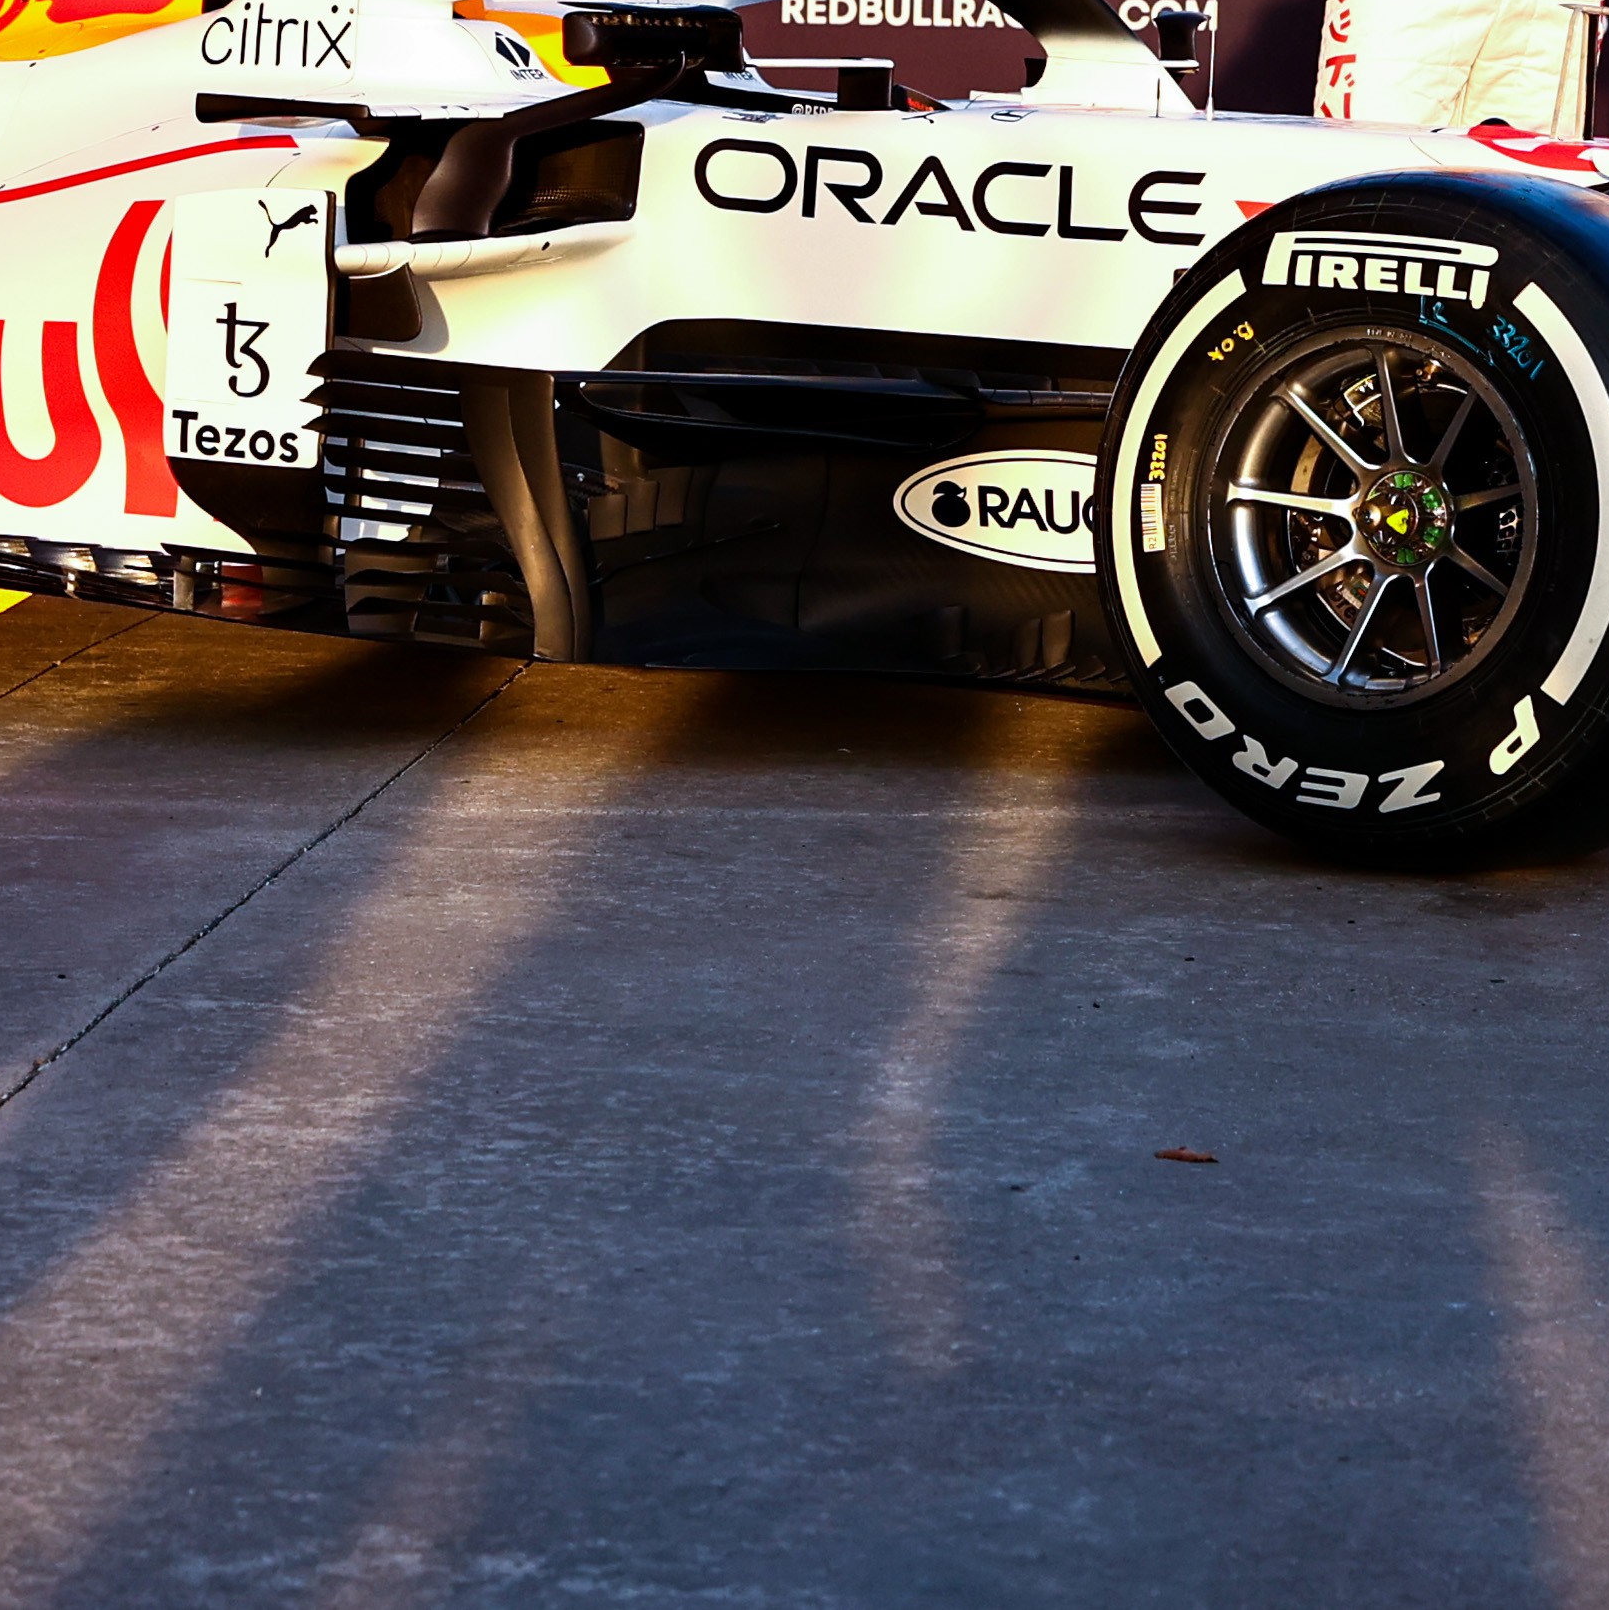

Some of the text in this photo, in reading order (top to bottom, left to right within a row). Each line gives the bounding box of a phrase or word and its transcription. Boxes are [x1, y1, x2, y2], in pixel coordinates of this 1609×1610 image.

[200, 2, 355, 70] citrix
[694, 137, 1208, 246] ORACLE
[1262, 230, 1499, 308] PIRELLI
[171, 410, 300, 464] Tezos
[978, 484, 1094, 535] RAU
[1164, 679, 1542, 814] P ZERO
